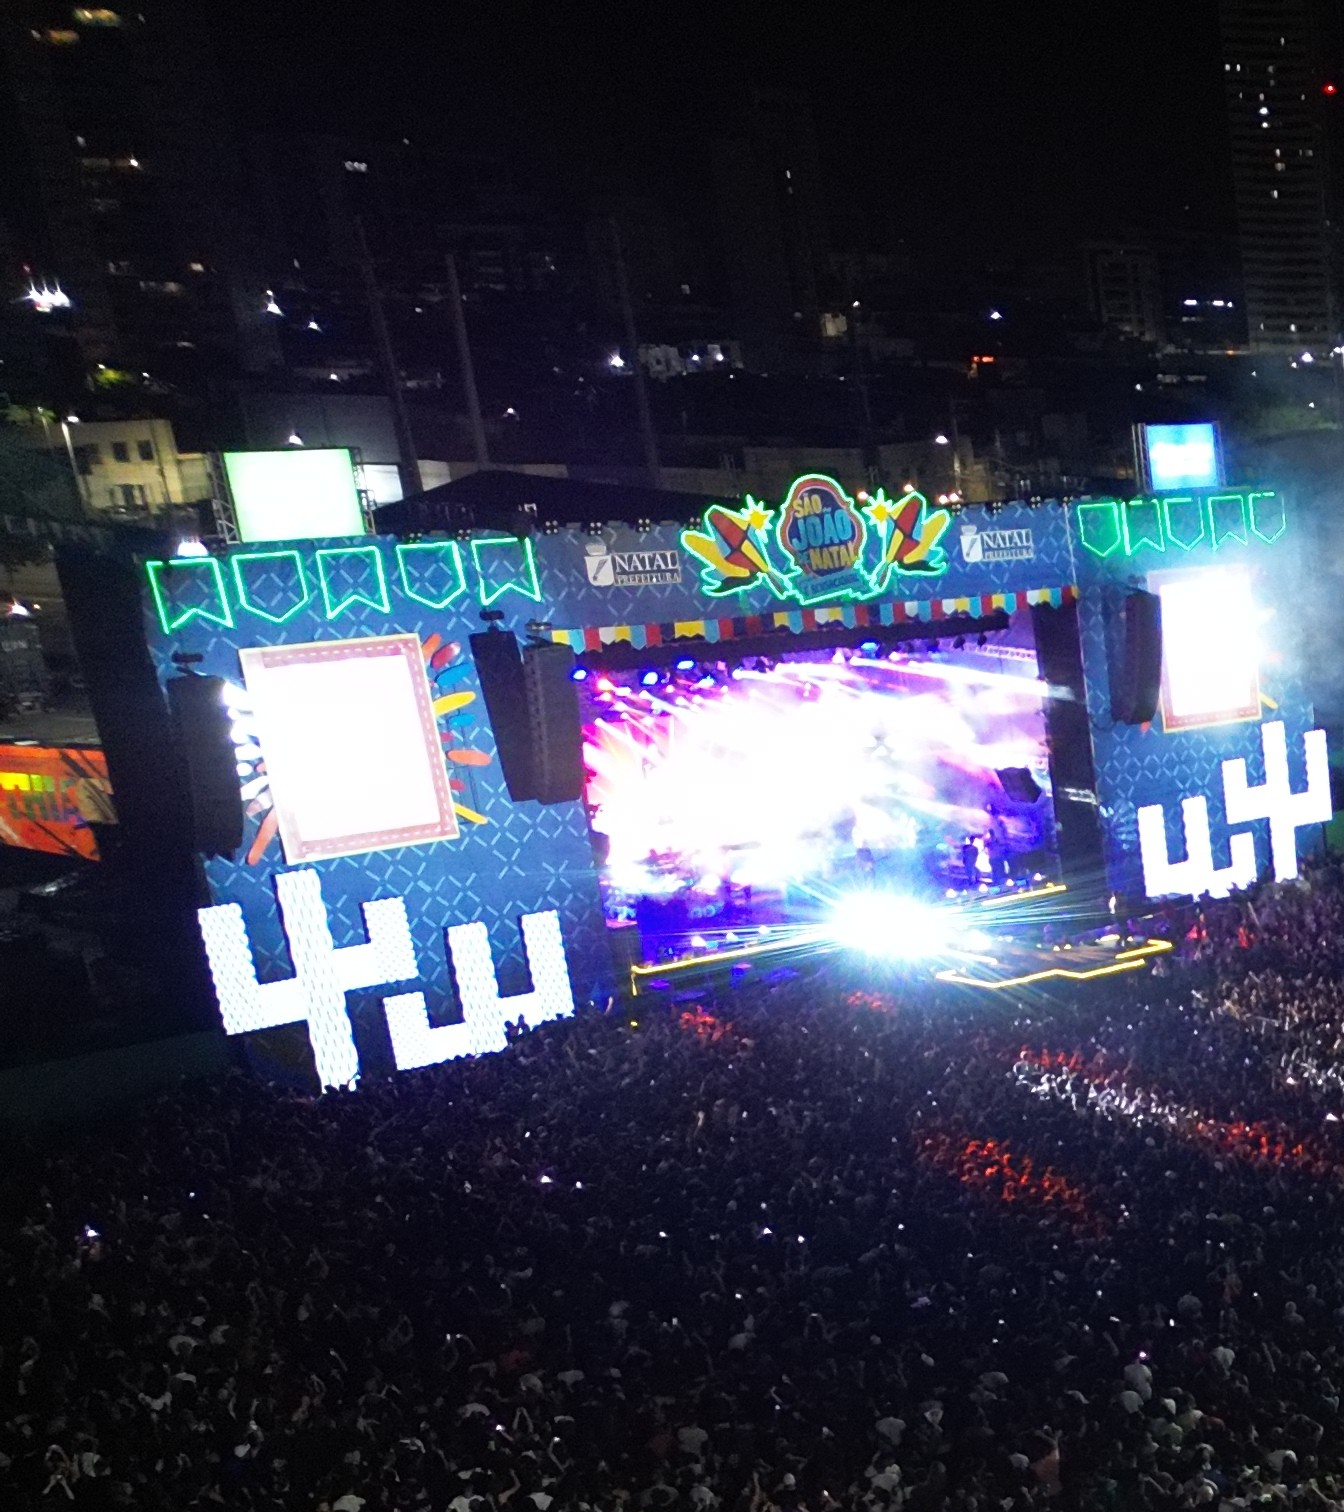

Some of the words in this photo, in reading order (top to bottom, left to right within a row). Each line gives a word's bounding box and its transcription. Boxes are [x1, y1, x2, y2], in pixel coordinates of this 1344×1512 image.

[793, 493, 822, 517] SÃO
[792, 507, 852, 551] JOÃO
[983, 531, 1031, 548] NATAL
[615, 553, 678, 572] NATAL
[618, 572, 681, 584] PREFEITURA
